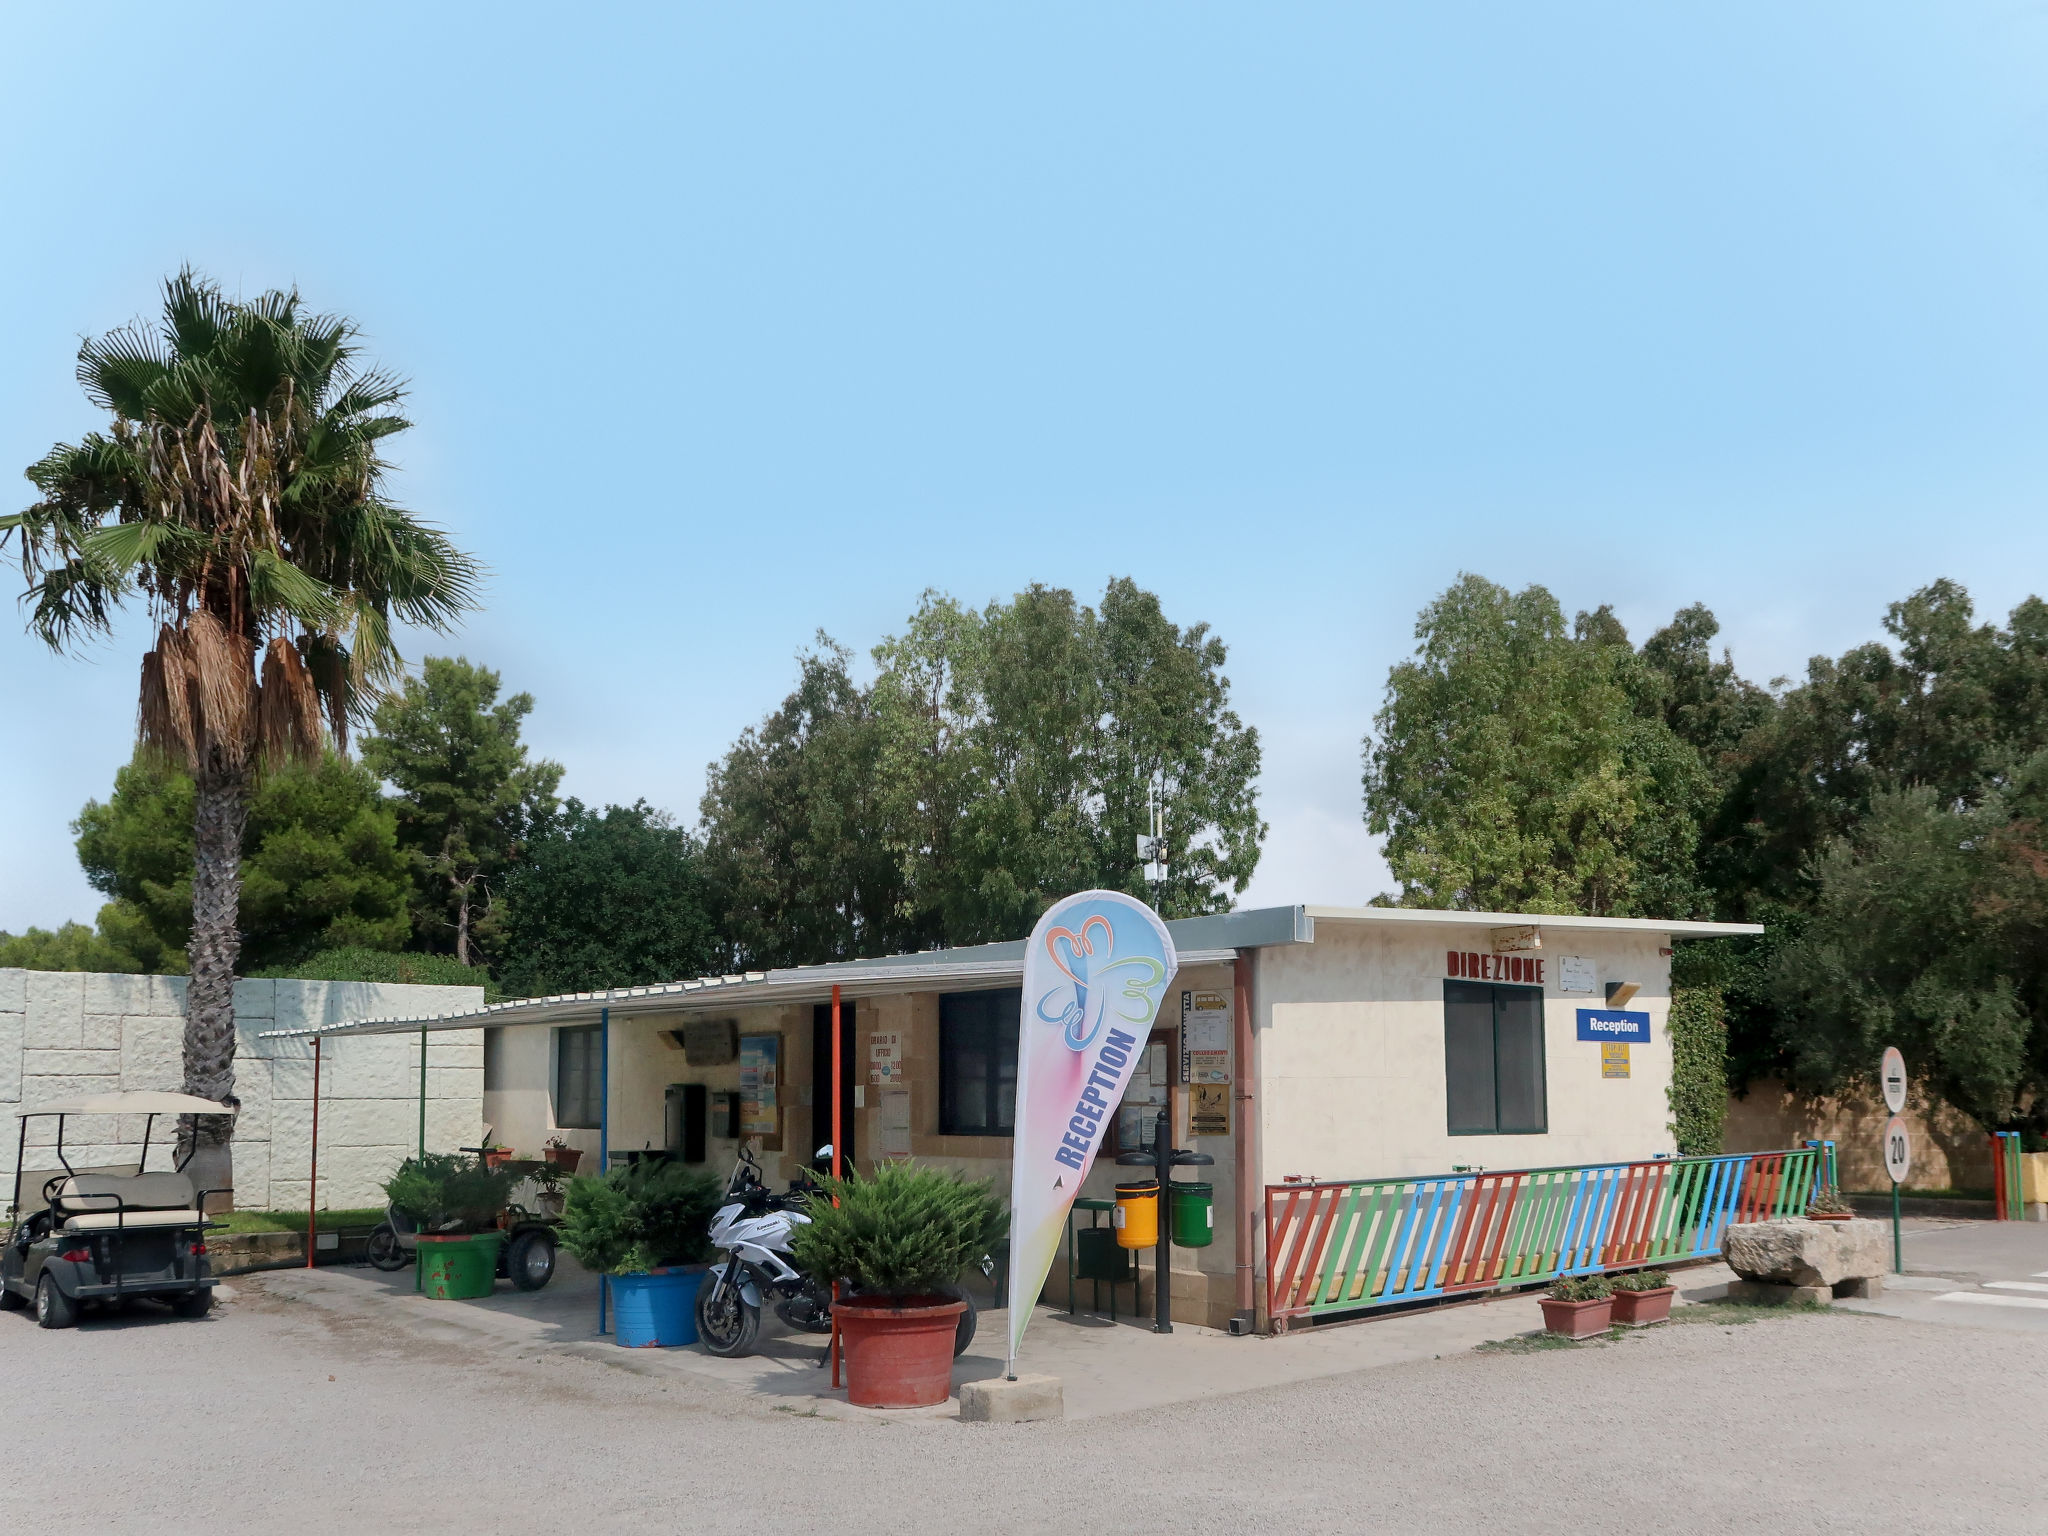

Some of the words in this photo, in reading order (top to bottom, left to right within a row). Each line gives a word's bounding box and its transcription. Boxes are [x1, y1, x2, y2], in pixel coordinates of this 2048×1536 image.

[1447, 950, 1545, 984] DIREZIONE
[1589, 1017, 1639, 1035] Reception
[1054, 1027, 1137, 1171] RECEPTION
[1891, 1135, 1905, 1164] 20
[757, 1220, 780, 1231] Kawasaki
